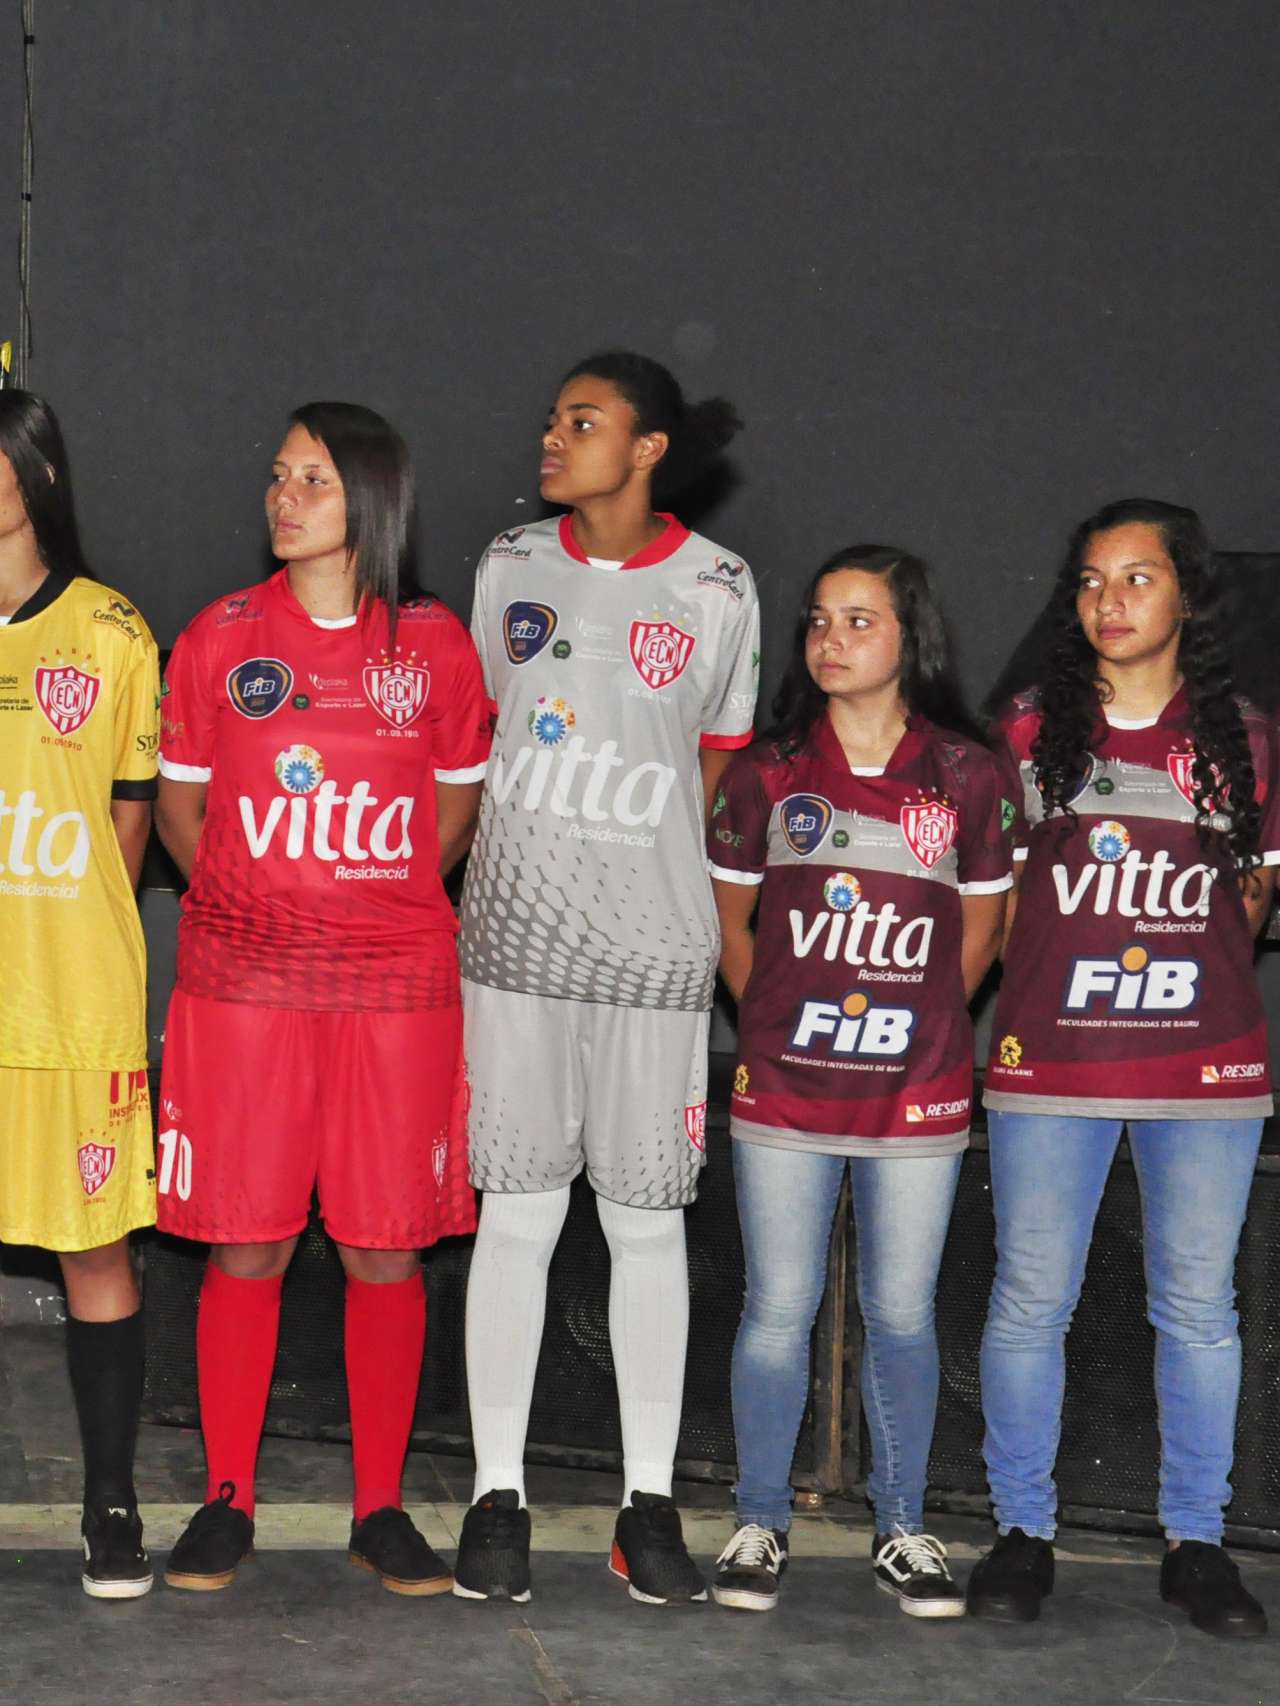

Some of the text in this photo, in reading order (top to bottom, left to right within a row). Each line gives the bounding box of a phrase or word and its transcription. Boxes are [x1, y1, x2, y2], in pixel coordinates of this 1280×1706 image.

[492, 736, 677, 828] vitta
[238, 780, 414, 862] vitta
[567, 823, 656, 849] Residencial
[0, 879, 80, 899] Residencial
[1051, 850, 1218, 918] vitta
[789, 901, 934, 968] vitta
[1135, 920, 1206, 934] Residencial
[857, 969, 924, 983] Residencial
[1057, 1018, 1108, 1028] FACULDADES
[1109, 1019, 1159, 1029] INTEGRADAS
[1160, 1020, 1171, 1029] DE
[780, 1054, 826, 1067] FACULDADES
[827, 1060, 874, 1072] INTEGRADAS
[875, 1064, 885, 1072] DE
[158, 1128, 193, 1201] 10
